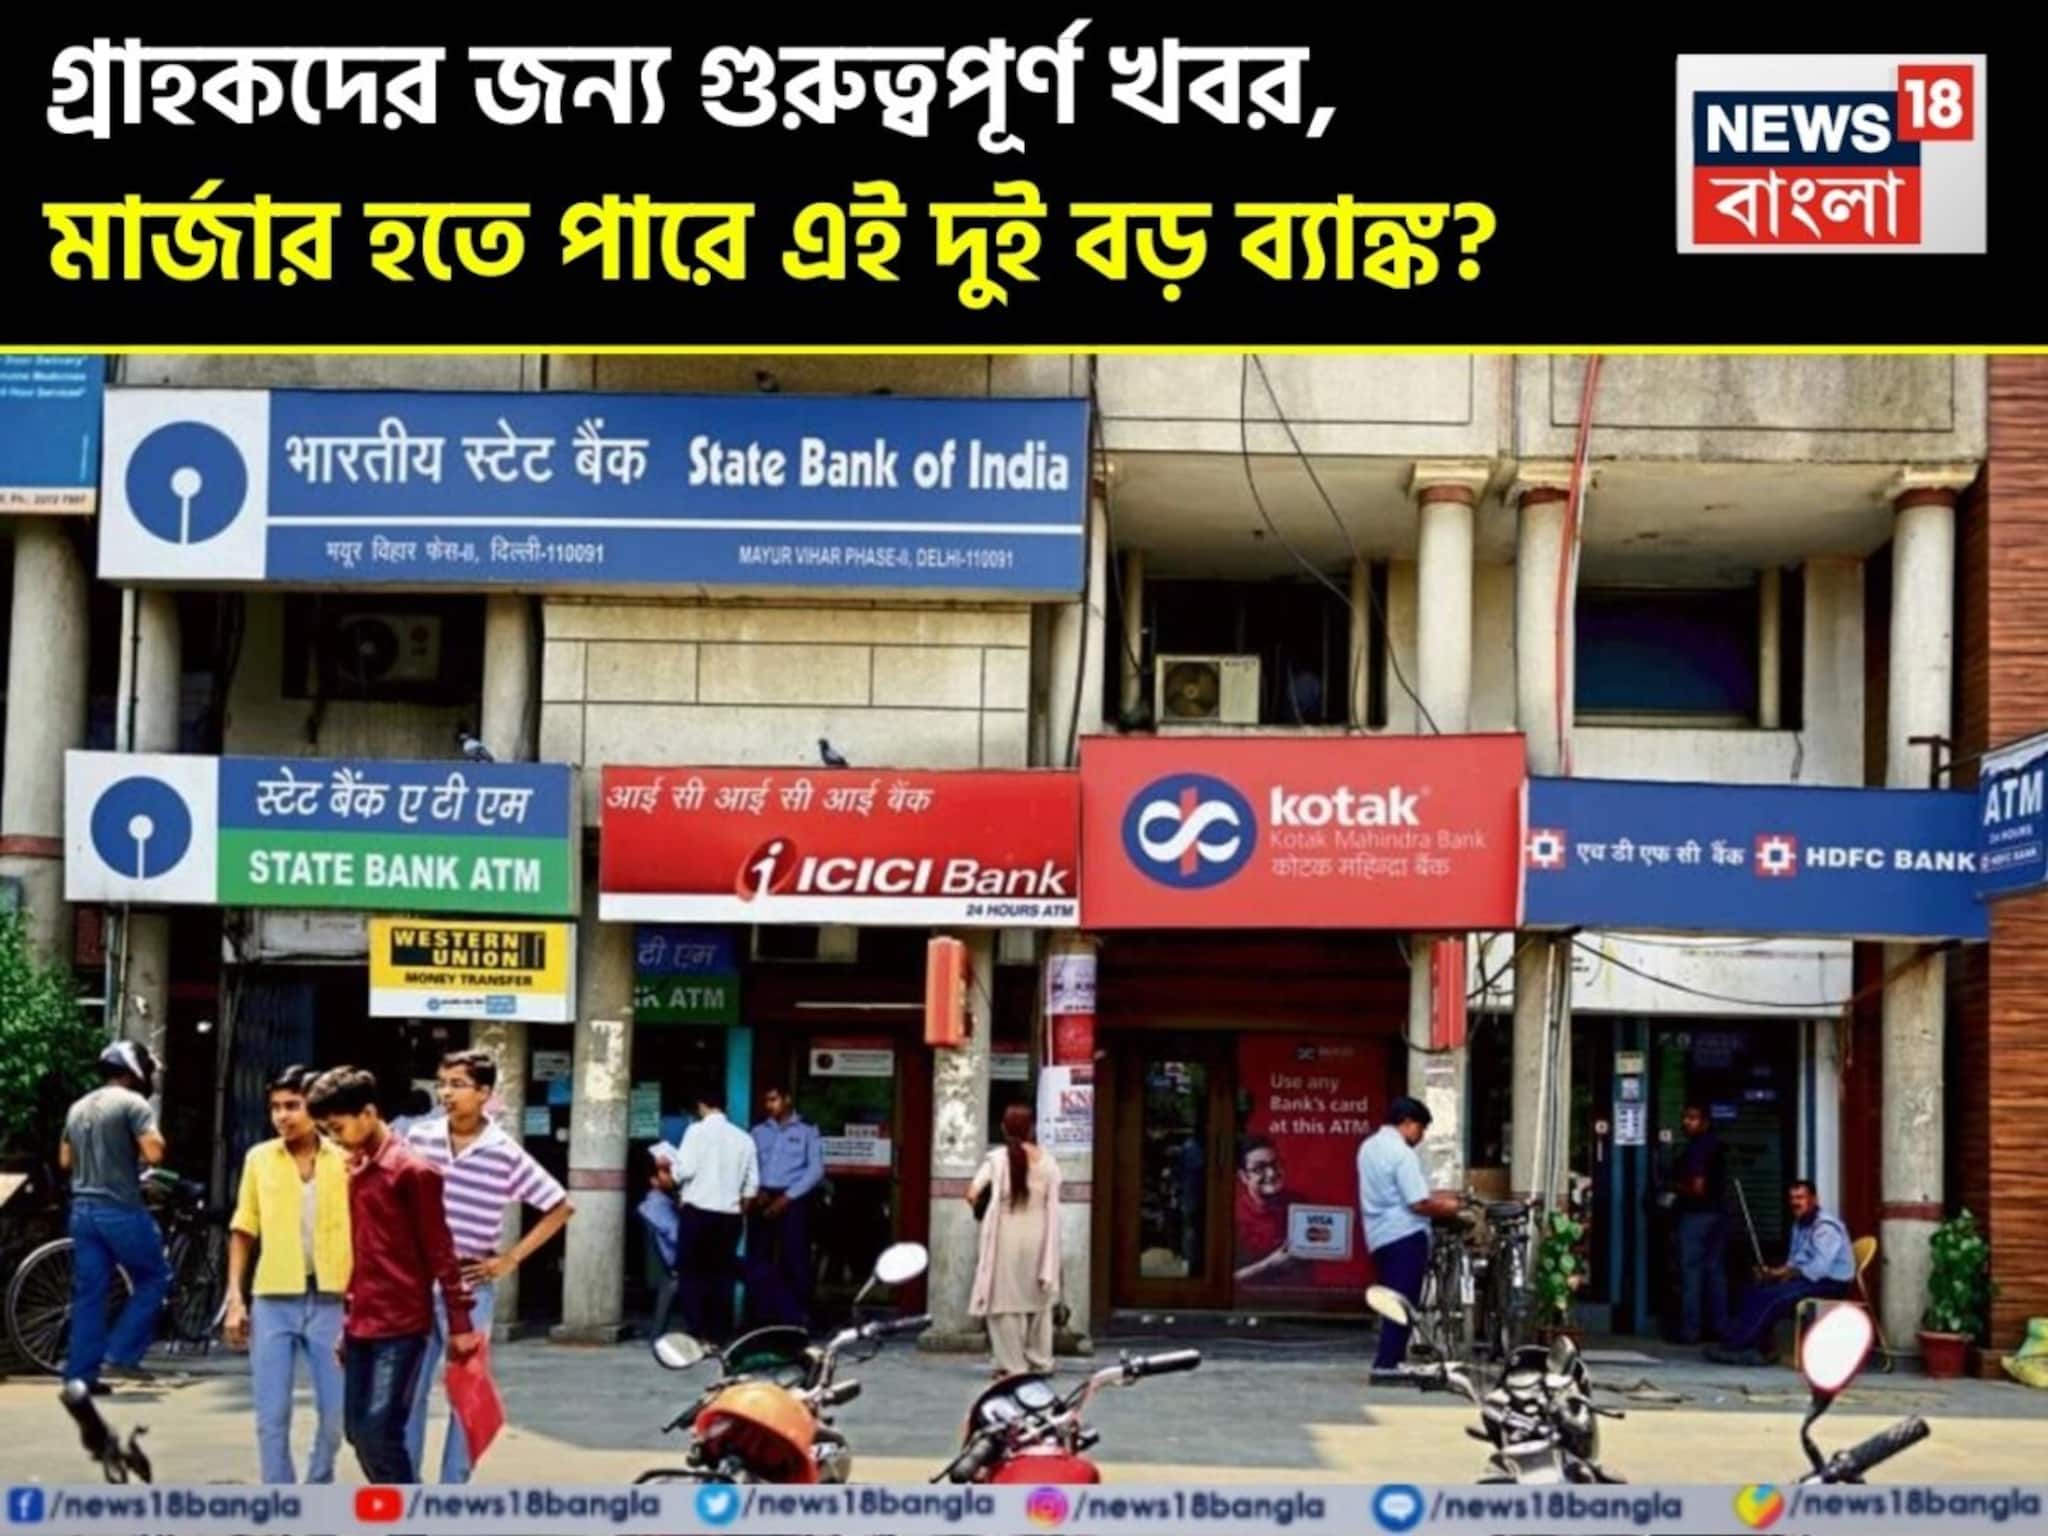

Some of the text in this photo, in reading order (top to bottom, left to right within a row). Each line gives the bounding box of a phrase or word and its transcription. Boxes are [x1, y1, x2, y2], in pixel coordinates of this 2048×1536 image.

[285, 416, 650, 485] भारतीय स्टेट बैंक
[688, 434, 1069, 490] State Bank of India
[326, 541, 363, 568] मयूर
[372, 534, 417, 564] विहार
[739, 546, 792, 566] MAYUR
[795, 546, 842, 567] VIHAR
[917, 549, 1014, 570] DELHI-110091
[256, 766, 534, 826] स्टेट बैंक ए टी एम
[606, 776, 664, 814] आई
[671, 775, 707, 811] सी
[714, 777, 773, 815] आई
[779, 777, 814, 812] सी
[823, 778, 881, 816] आई
[1269, 784, 1420, 826] kotak
[1984, 770, 2043, 826] ATM
[1269, 829, 1487, 849] Kotak Mahindra Bank
[249, 850, 541, 892] STATE BANK ATM
[1806, 847, 1976, 872] HDFC BANK
[796, 857, 930, 893] ICICI
[941, 858, 1069, 896] Bank
[966, 904, 1075, 919] 24 HOURS ATM
[393, 929, 519, 949] WESTERN
[432, 950, 519, 968] UNION
[405, 972, 533, 987] MONEY TRANSFER
[669, 986, 725, 1010] ATM
[1271, 1073, 1340, 1094] Use any
[1270, 1096, 1369, 1113] Bank's card
[1269, 1118, 1371, 1136] at this ATM
[1306, 1215, 1334, 1226] VISA
